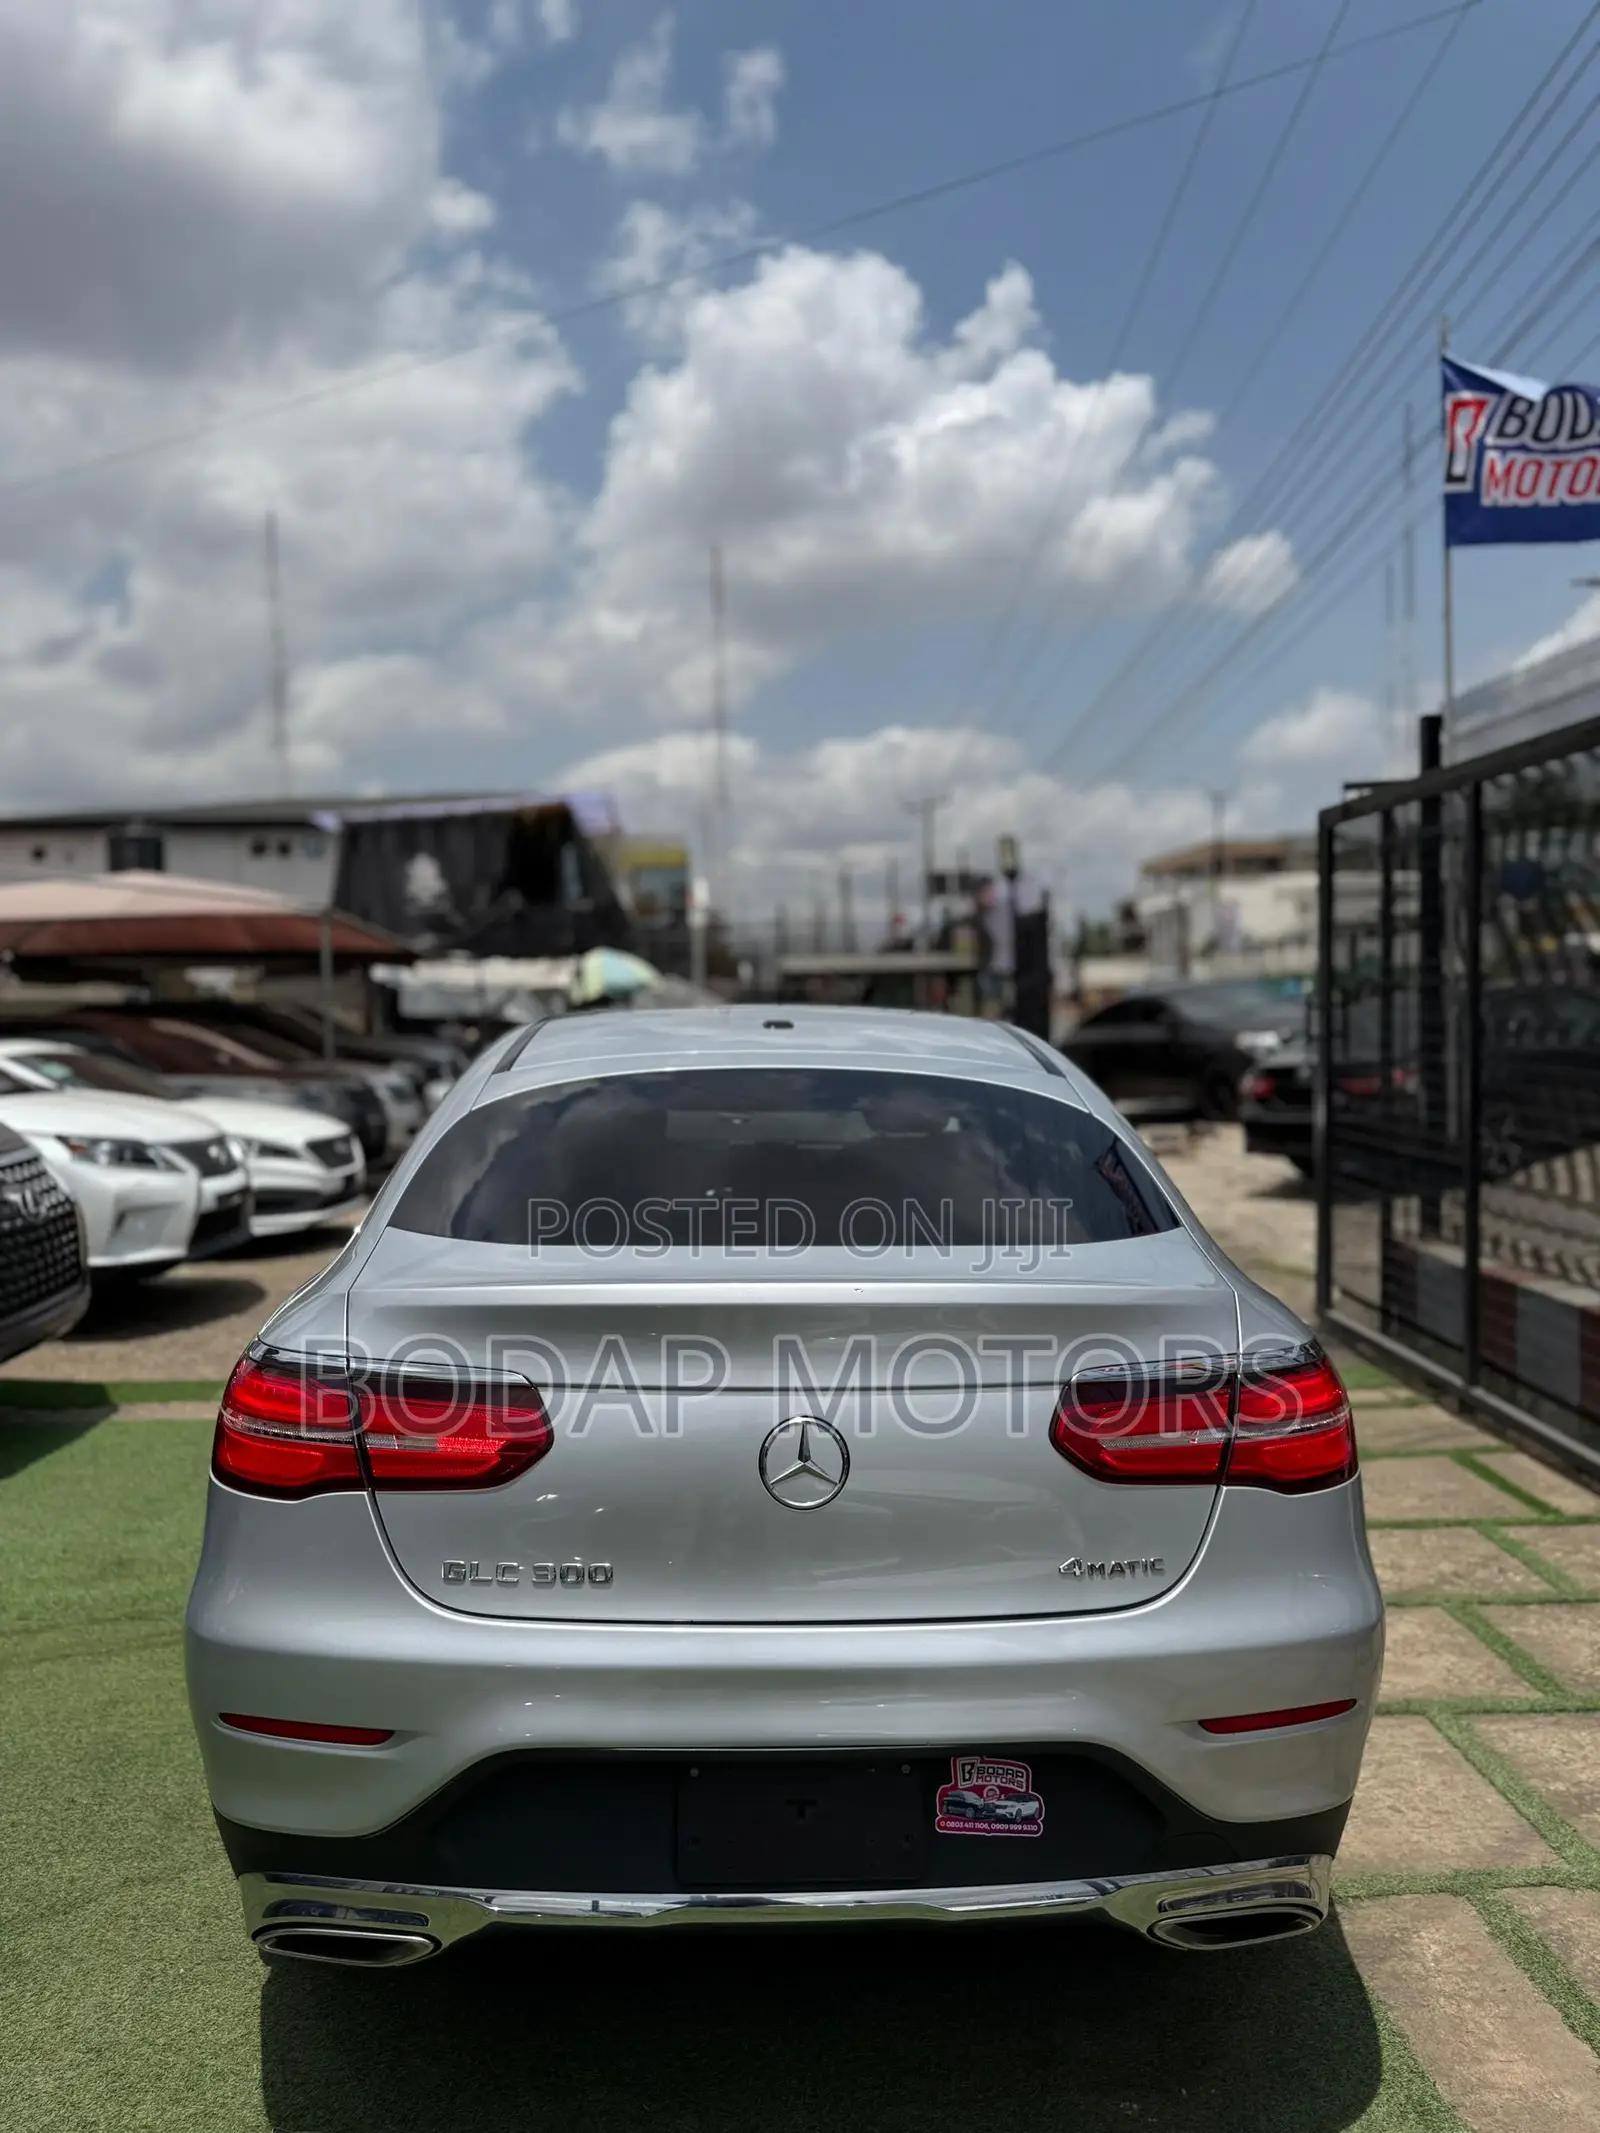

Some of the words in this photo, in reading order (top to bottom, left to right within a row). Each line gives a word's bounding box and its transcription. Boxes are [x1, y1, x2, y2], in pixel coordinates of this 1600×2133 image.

[1496, 391, 1600, 443] BOD
[1484, 455, 1600, 498] MOTO
[441, 1560, 519, 1583] GLC
[531, 1562, 614, 1584] 300
[1058, 1556, 1165, 1577] 4MATIC
[976, 1766, 1025, 1779] BODAP
[976, 1775, 1024, 1790] MOTORS
